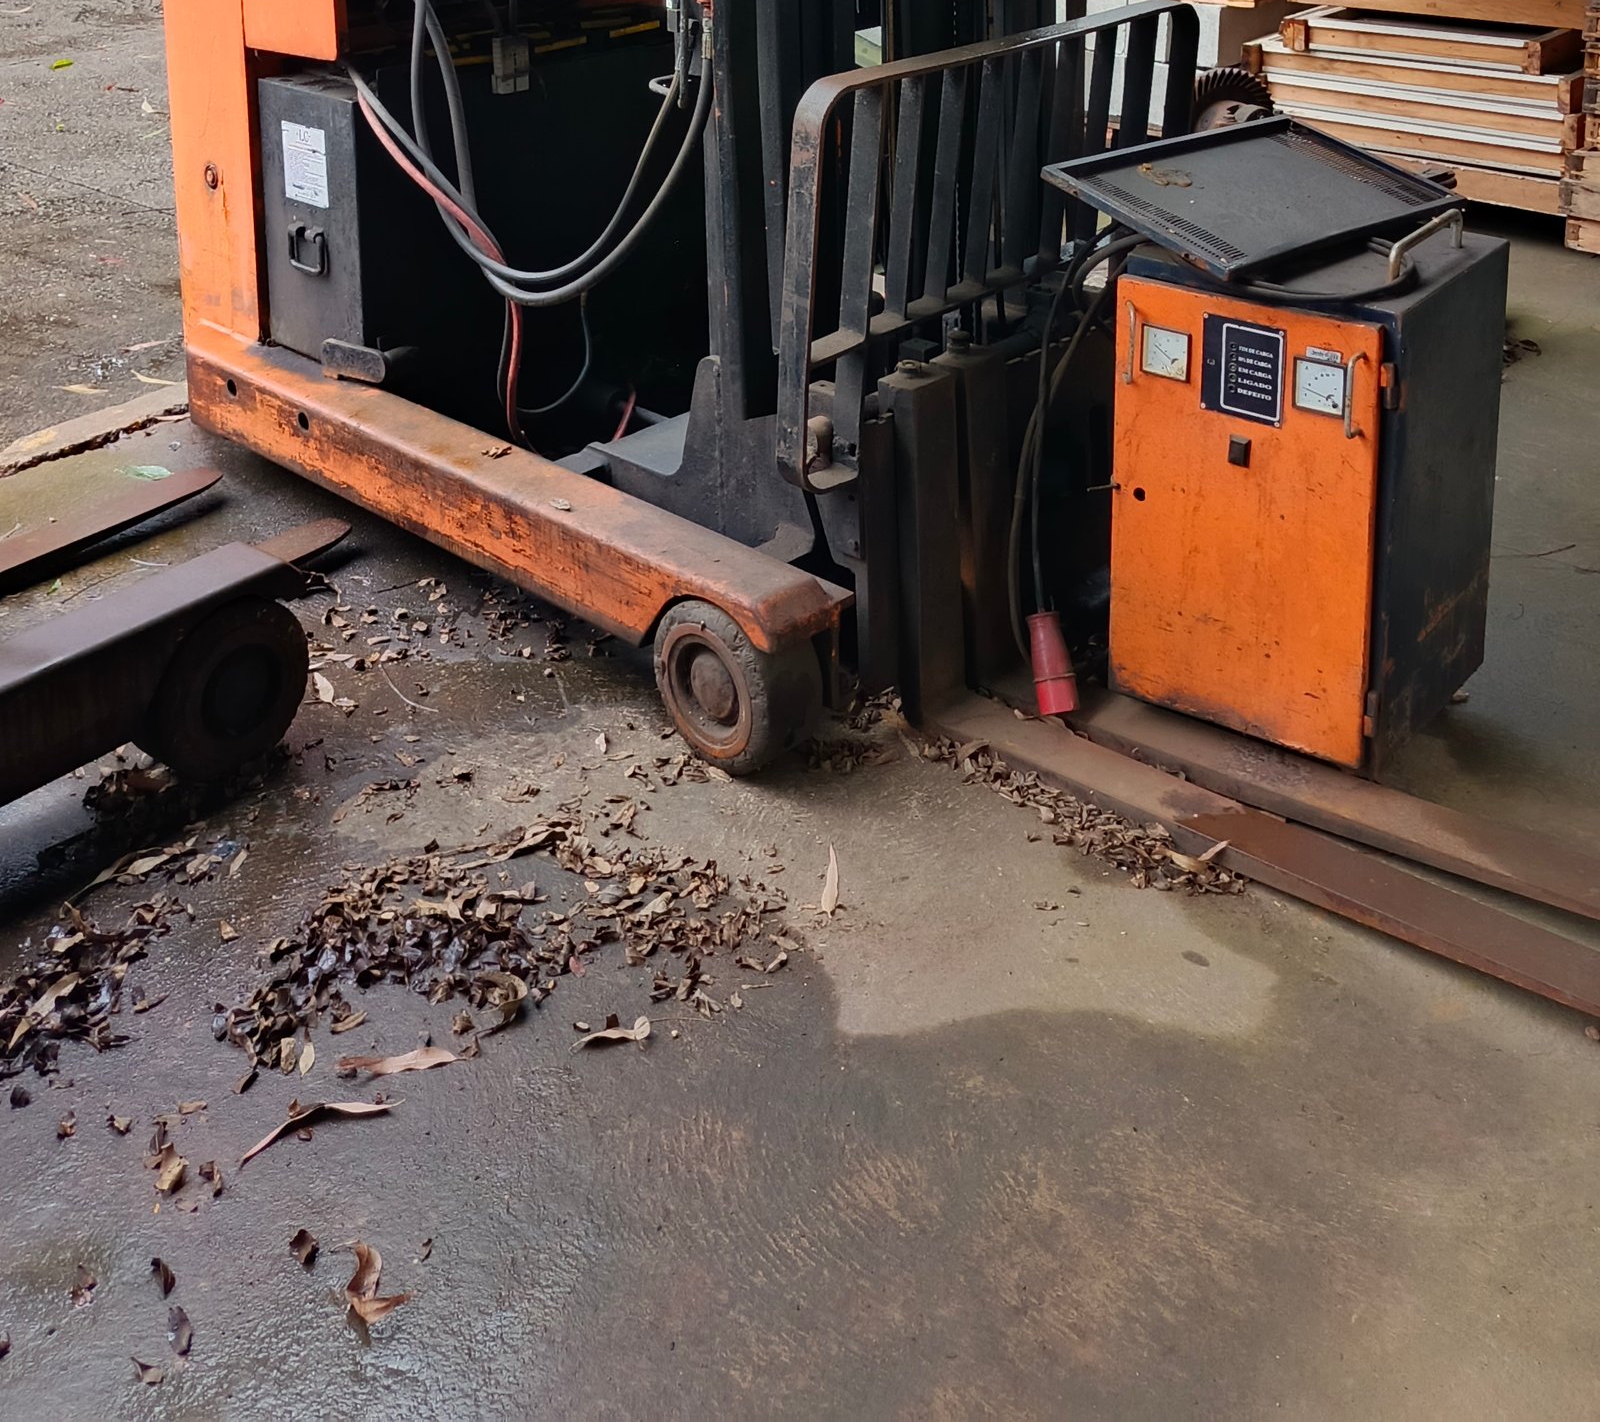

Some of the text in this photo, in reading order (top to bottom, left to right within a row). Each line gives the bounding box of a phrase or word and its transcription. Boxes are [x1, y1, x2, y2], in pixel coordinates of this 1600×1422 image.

[1255, 350, 1273, 358] CARGA
[1254, 360, 1272, 369] CARGA
[1249, 369, 1272, 380] CARGA
[1237, 377, 1272, 390] LIGADO
[1237, 388, 1272, 401] DEFEITO
